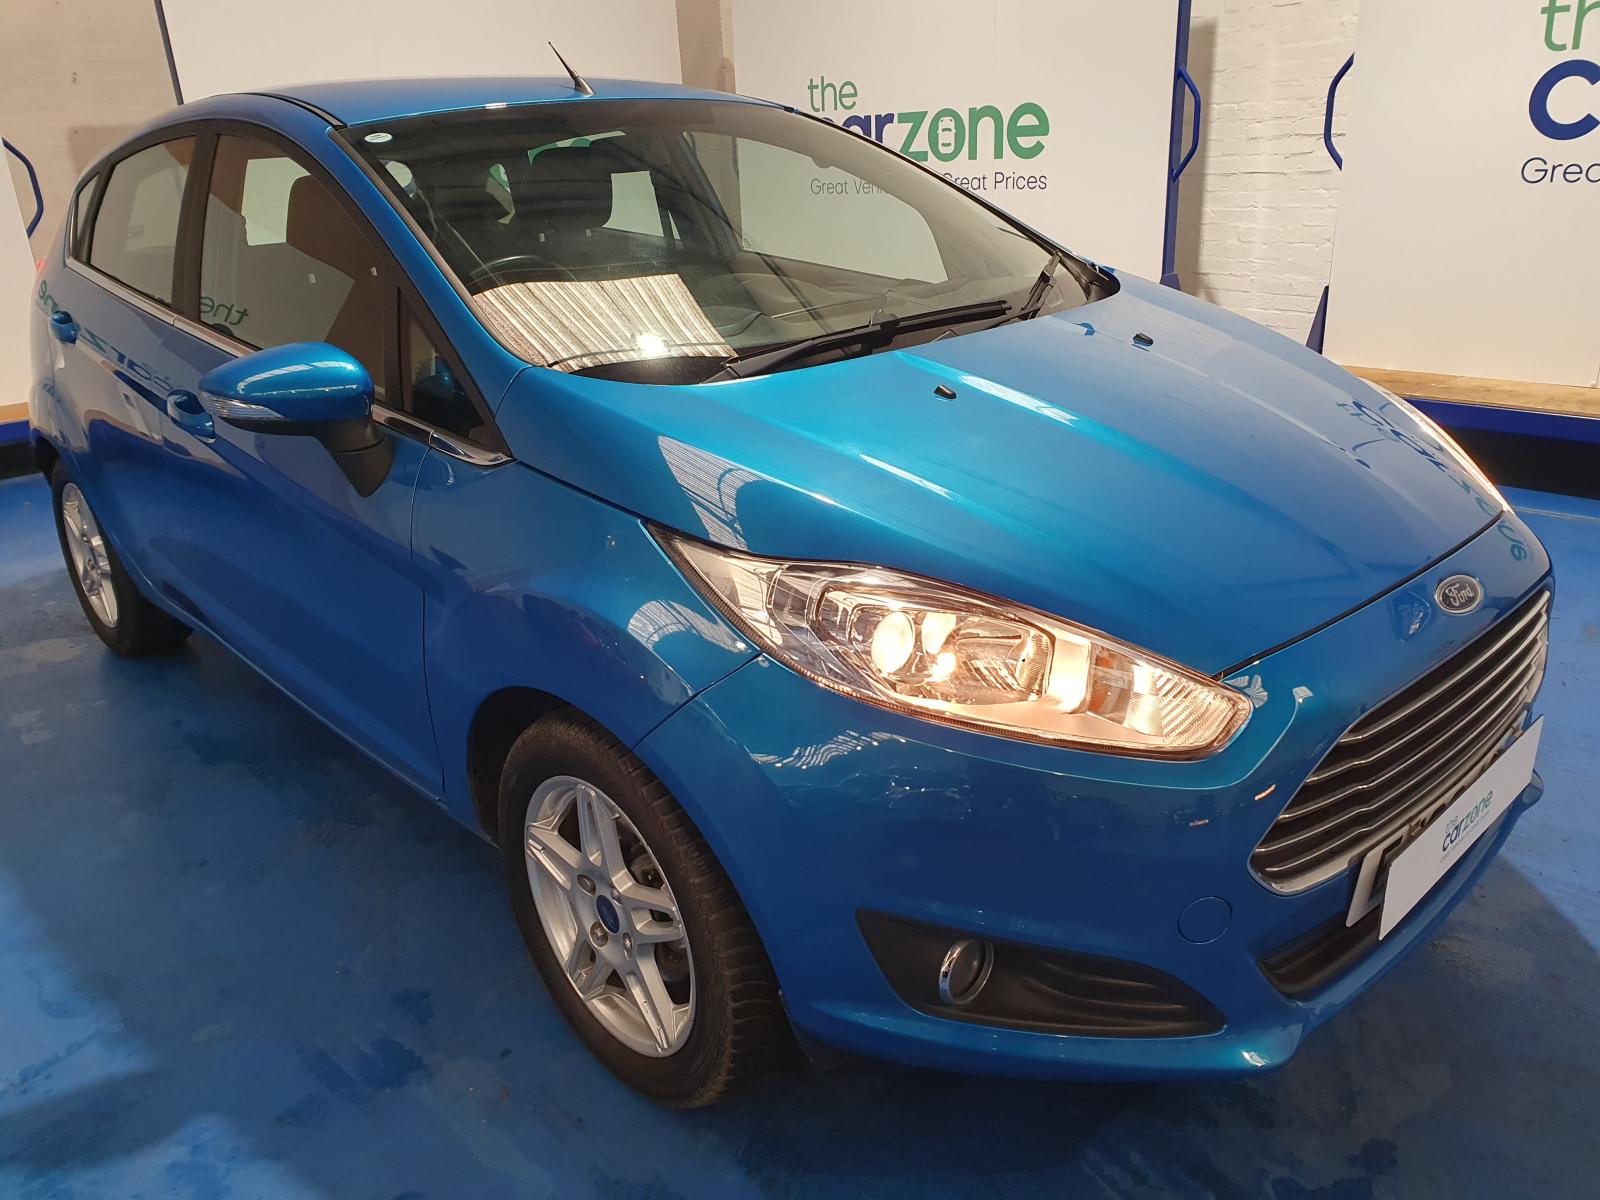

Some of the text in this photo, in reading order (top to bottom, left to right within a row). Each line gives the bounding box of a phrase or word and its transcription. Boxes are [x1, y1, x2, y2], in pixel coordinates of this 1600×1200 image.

[807, 75, 858, 112] the
[822, 102, 1050, 162] rzone
[810, 178, 848, 195] Great
[994, 171, 1048, 190] Prices
[1445, 583, 1475, 607] Ford
[1442, 790, 1493, 852] carzone
